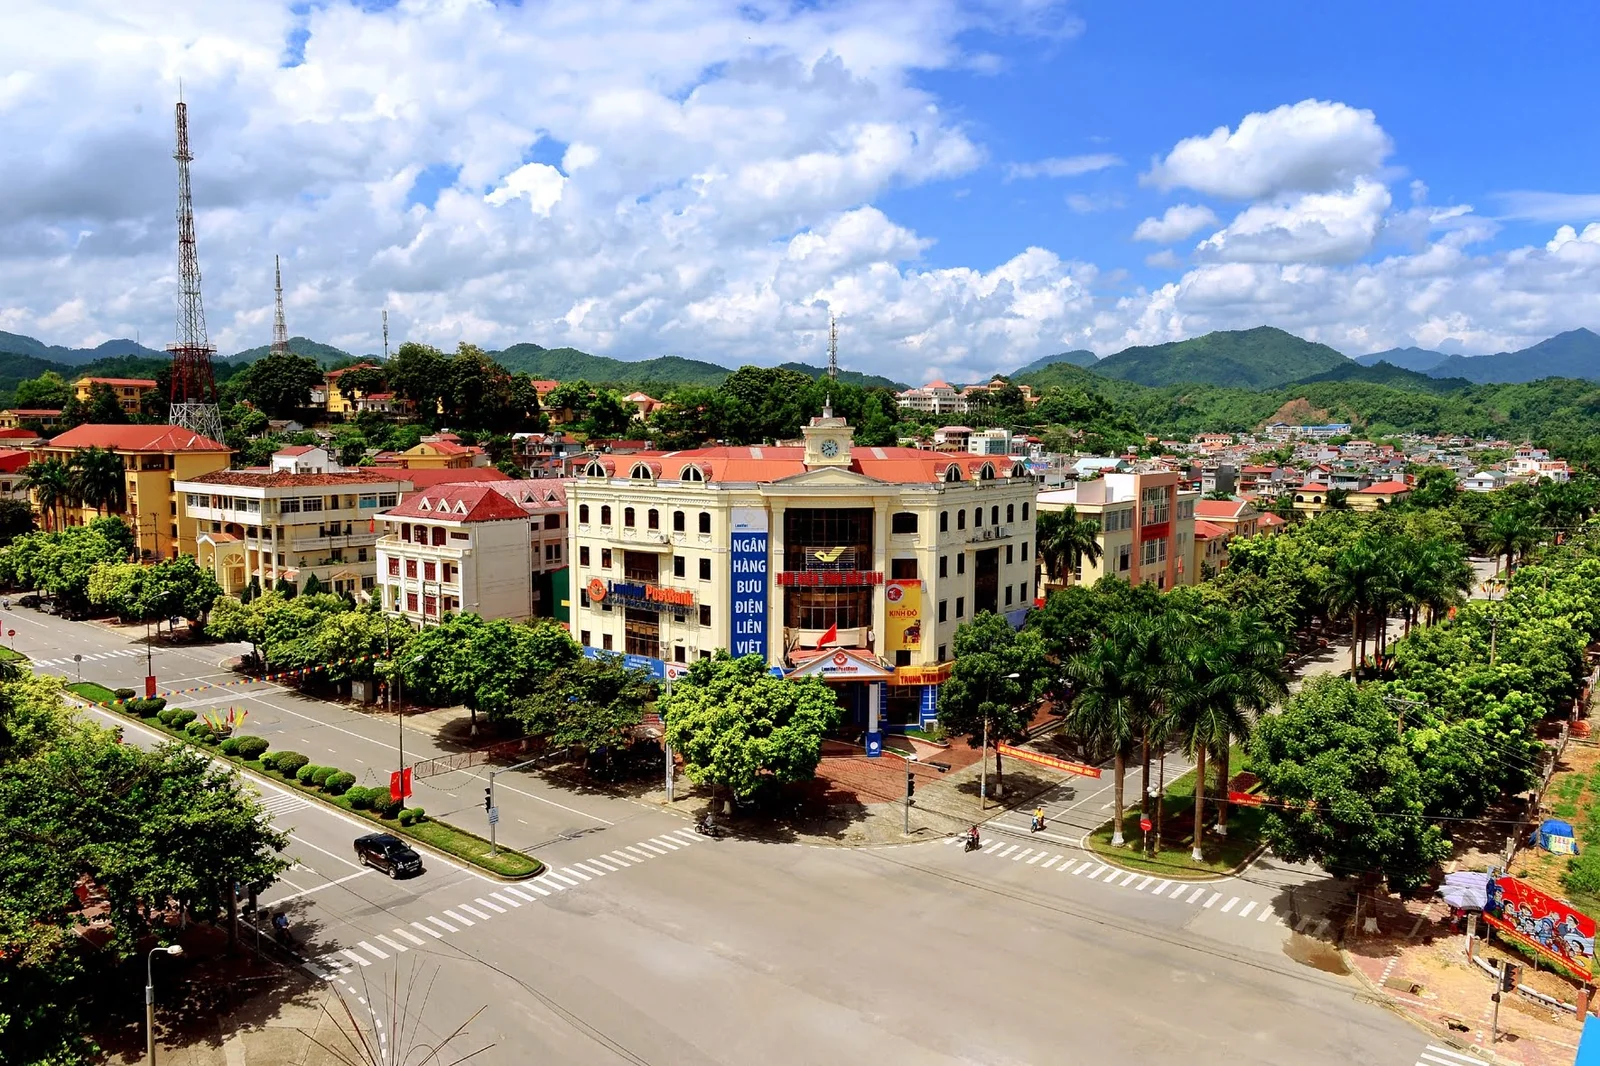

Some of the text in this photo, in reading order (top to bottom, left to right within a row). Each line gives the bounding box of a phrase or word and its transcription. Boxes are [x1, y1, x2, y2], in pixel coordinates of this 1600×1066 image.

[733, 537, 766, 552] NGÂN
[733, 558, 766, 573] HÀNG
[608, 580, 694, 606] LPostBank
[737, 579, 762, 593] BƯU
[735, 599, 763, 617] ĐIỆN
[907, 609, 917, 617] ĐÔ
[736, 619, 762, 634] LIÊN
[900, 675, 921, 684] TRUNG
